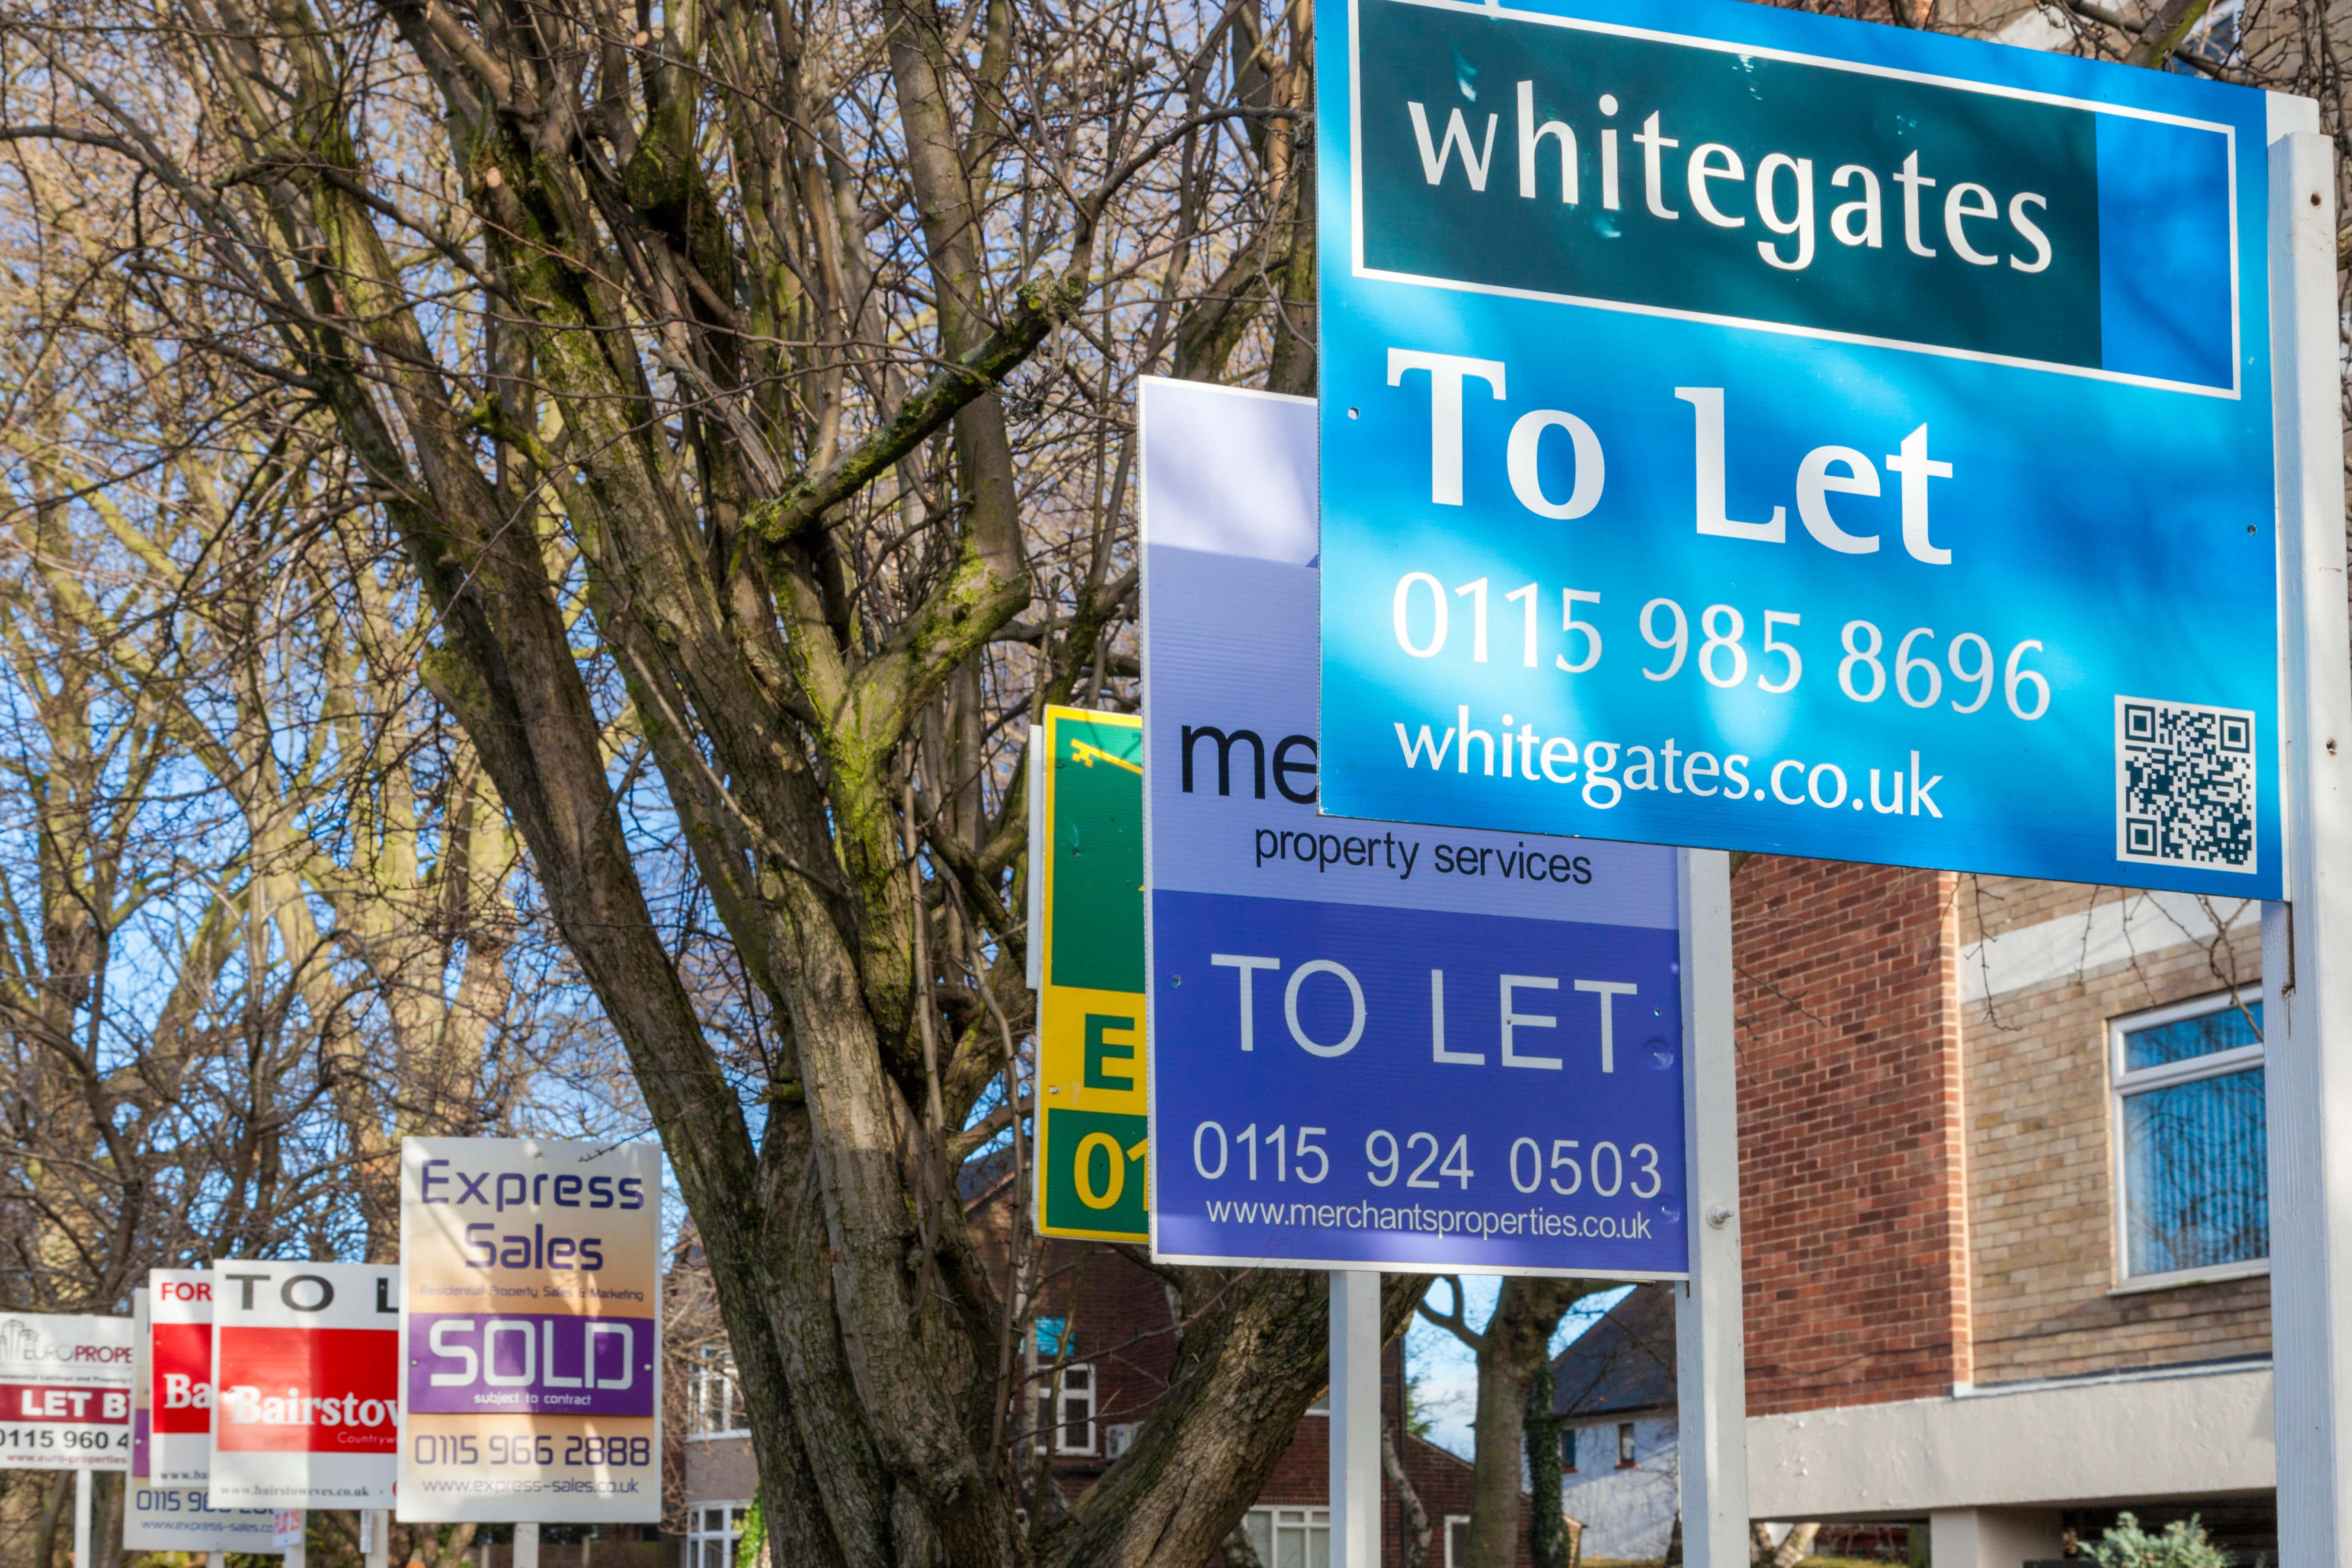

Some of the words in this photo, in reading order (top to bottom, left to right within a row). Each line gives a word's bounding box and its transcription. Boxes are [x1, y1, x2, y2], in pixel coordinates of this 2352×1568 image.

[1407, 80, 2053, 274] whitegates
[1388, 348, 1605, 519] To
[1675, 387, 1952, 565] Let
[1393, 571, 1602, 674] 0115
[1640, 598, 1802, 694] 985
[1840, 620, 2051, 721] 8696
[1181, 725, 1317, 804] me
[1395, 704, 1943, 819] whitegates.co.uk
[1256, 829, 1419, 880] property
[1434, 843, 1592, 884] services
[1211, 954, 1366, 1057] TO
[1431, 970, 1637, 1073] LET
[1085, 1013, 1135, 1091] E
[1074, 1132, 1148, 1211] 01
[1194, 1121, 1328, 1184] 0115
[1366, 1130, 1474, 1190] 924
[1510, 1137, 1661, 1199] 0503
[422, 1159, 644, 1213] Express
[1206, 1200, 1651, 1240] www.merchantsproperties.co.uk
[466, 1223, 603, 1271] Sales
[162, 1283, 212, 1301] FOR
[225, 1274, 334, 1312] TO
[420, 1285, 483, 1296] Residential
[490, 1286, 538, 1298] Property
[543, 1287, 573, 1297] Sales
[579, 1288, 585, 1297] &
[590, 1288, 643, 1301] Marketing
[429, 1319, 634, 1391] SOLD
[22, 1389, 92, 1418] LET
[102, 1392, 130, 1419] B
[163, 1373, 211, 1409] Ba
[474, 1392, 519, 1406] subject
[525, 1393, 539, 1404] to
[544, 1394, 591, 1406] contract
[64, 1430, 108, 1449] 960
[337, 1431, 397, 1446] Countryw
[415, 1435, 478, 1466] 0115
[490, 1435, 553, 1466] 966
[565, 1436, 650, 1466] 2888
[136, 1490, 181, 1512] 0115
[221, 1485, 369, 1498] www.bairstoweves.co.uk
[422, 1477, 639, 1494] www.express-sales.co.uk
